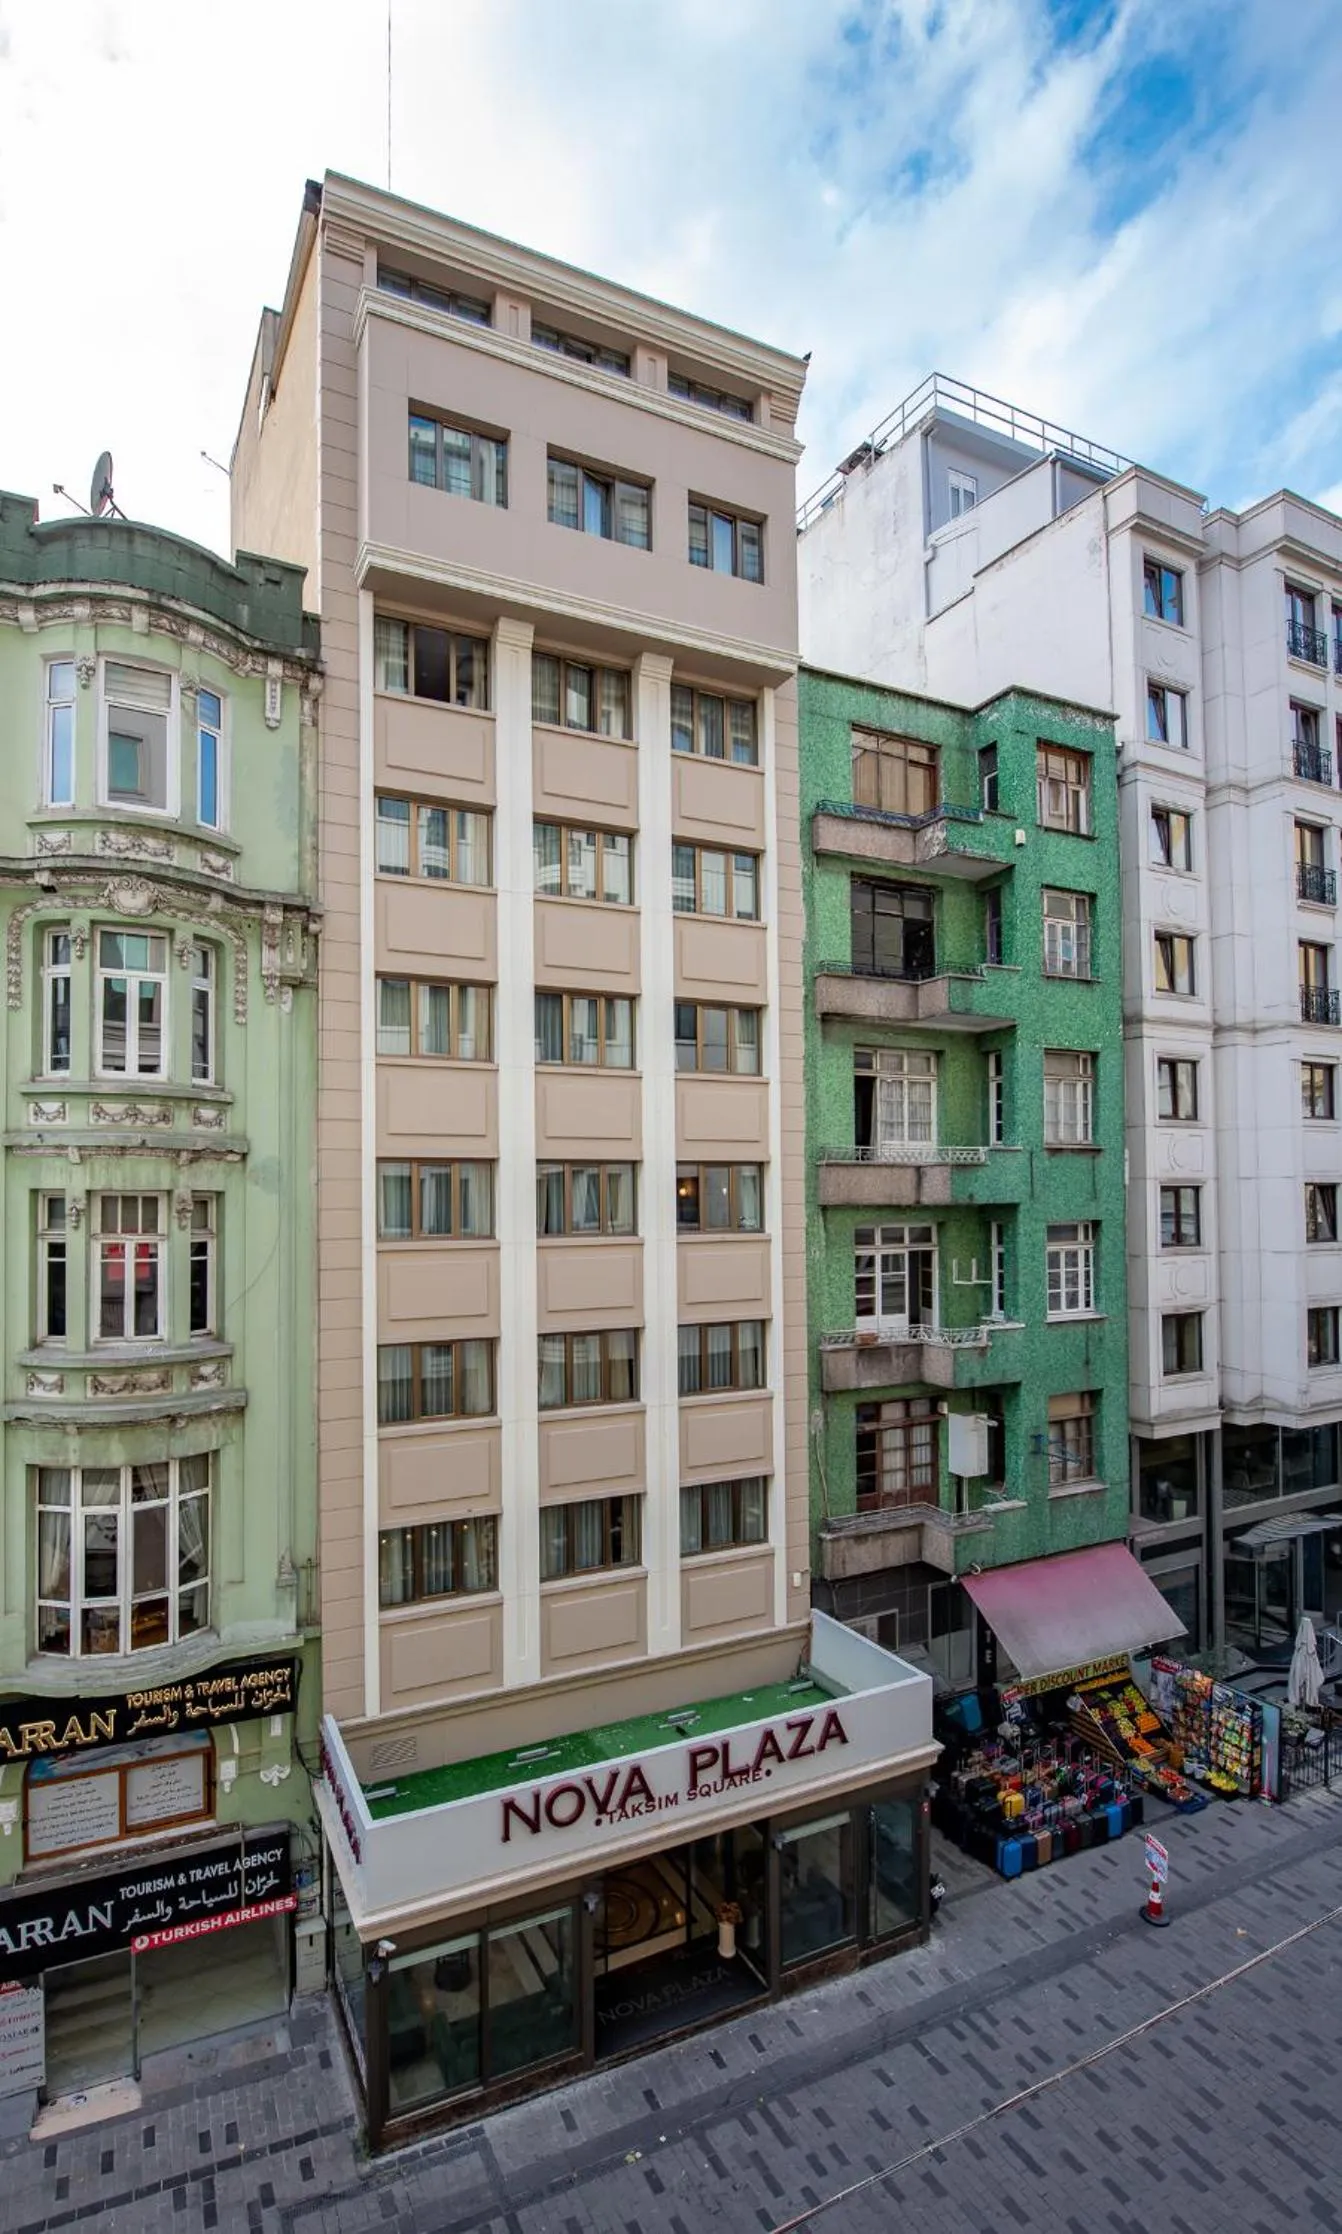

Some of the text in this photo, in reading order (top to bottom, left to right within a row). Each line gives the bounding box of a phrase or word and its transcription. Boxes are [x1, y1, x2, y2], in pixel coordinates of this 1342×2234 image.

[126, 1668, 291, 1710] TOURISM & TRAVEL AGENCY
[1040, 1666, 1090, 1690] DISCOUNT
[126, 1704, 180, 1735] والسفر
[185, 1691, 245, 1718] للسياحة
[501, 1709, 849, 1843] NOVA PLAZA
[609, 1769, 763, 1825] TAKSIM SQUARE
[119, 1847, 284, 1900] TOURISM & TRAVEL AGENCY
[178, 1880, 239, 1910] للسياحة
[120, 1899, 173, 1932] والسفر
[152, 1896, 295, 1945] TURKISH AIRLINES
[597, 1993, 660, 2025] NOVA
